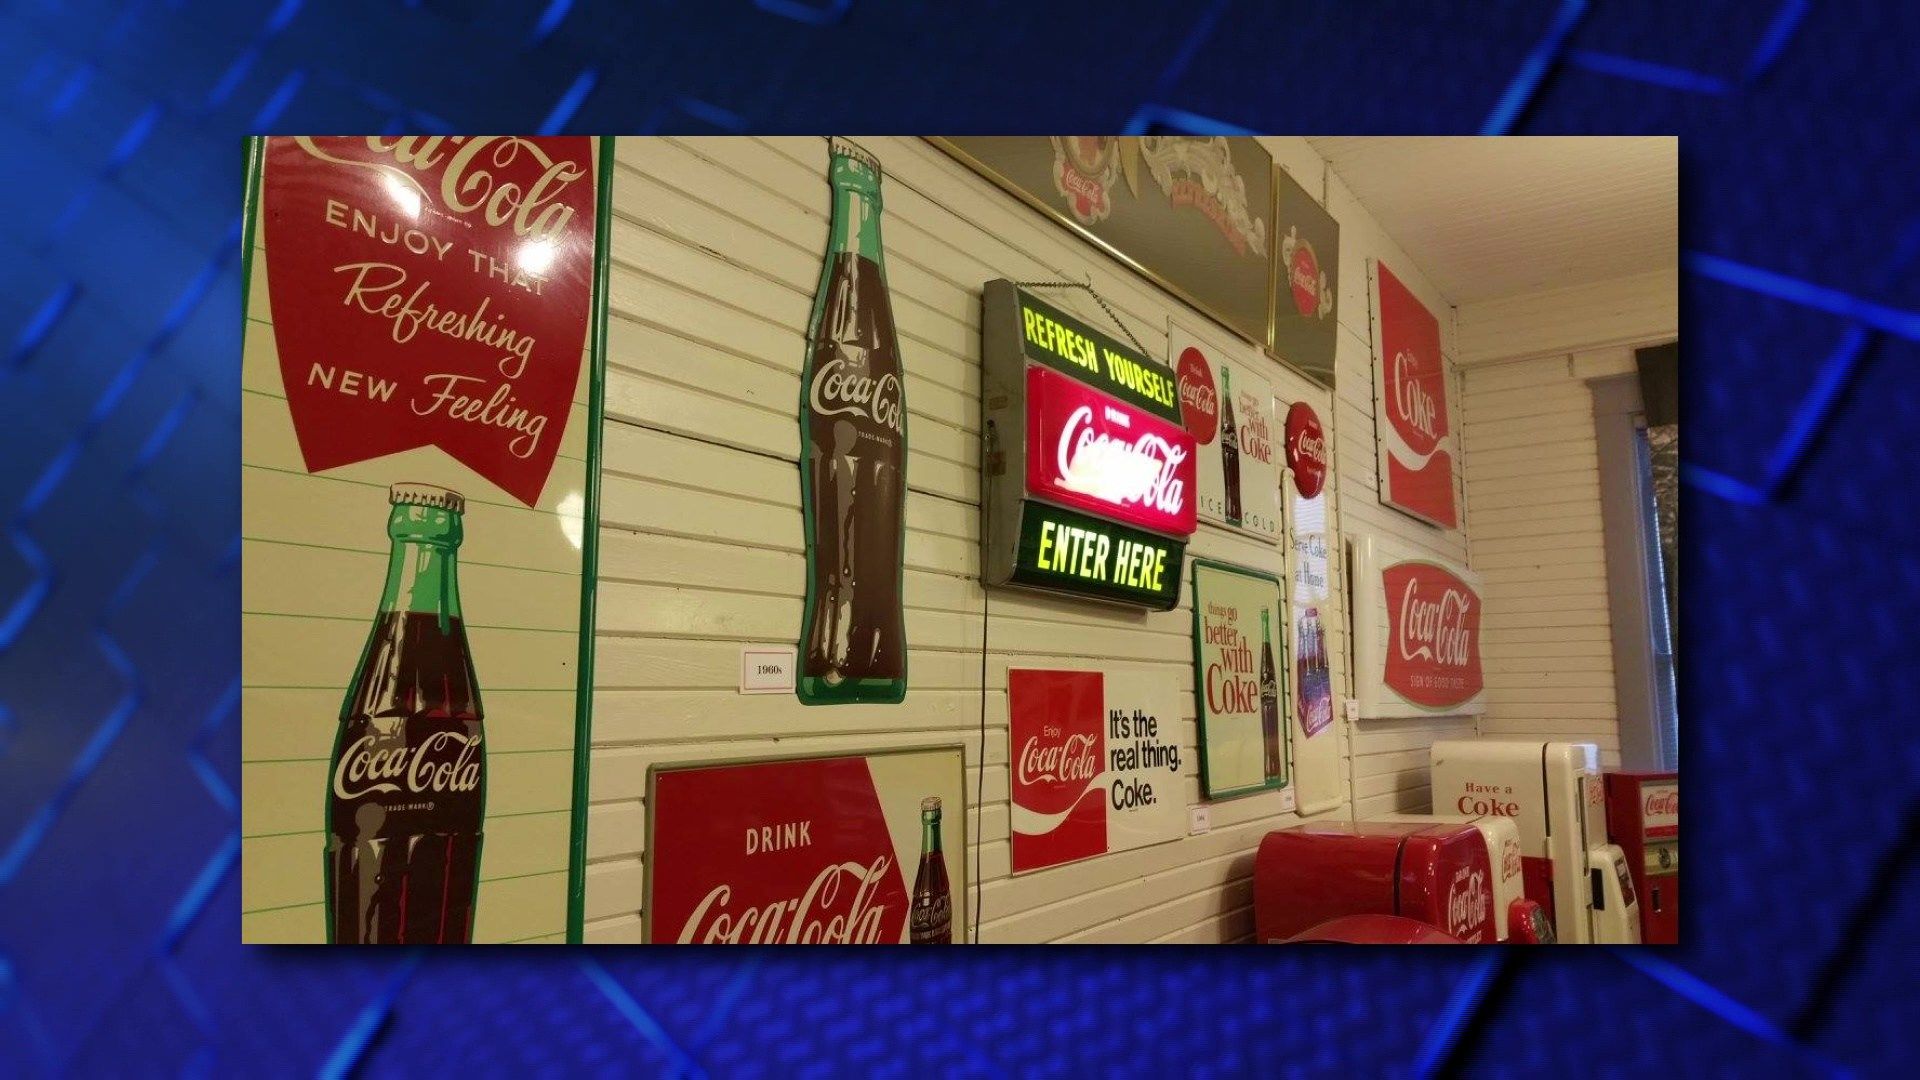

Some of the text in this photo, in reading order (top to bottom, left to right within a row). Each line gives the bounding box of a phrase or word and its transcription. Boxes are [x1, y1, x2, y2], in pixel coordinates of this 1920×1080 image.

[325, 199, 454, 261] ENJOY
[468, 248, 550, 296] THAT
[333, 261, 536, 379] Refreshing
[1023, 306, 1174, 409] REFRESH YOURSELF
[307, 362, 549, 459] NEW Feeling
[1395, 351, 1438, 440] Coke
[1240, 424, 1272, 465] Coke
[1037, 520, 1167, 592] ENTER HERE
[1204, 615, 1238, 647] better
[1401, 576, 1471, 668] Coca-Cola
[756, 664, 783, 675] 1960s
[1220, 635, 1254, 674] with
[1206, 662, 1258, 715] Coke
[1109, 709, 1158, 740] It's the
[333, 731, 483, 800] Coca-Cola
[1018, 733, 1097, 786] Coca-Cola
[1110, 739, 1182, 773] real thing.
[1111, 777, 1157, 811] Coke.
[1457, 796, 1520, 818] Coke
[1465, 782, 1513, 795] Have a
[745, 820, 813, 856] DRINK
